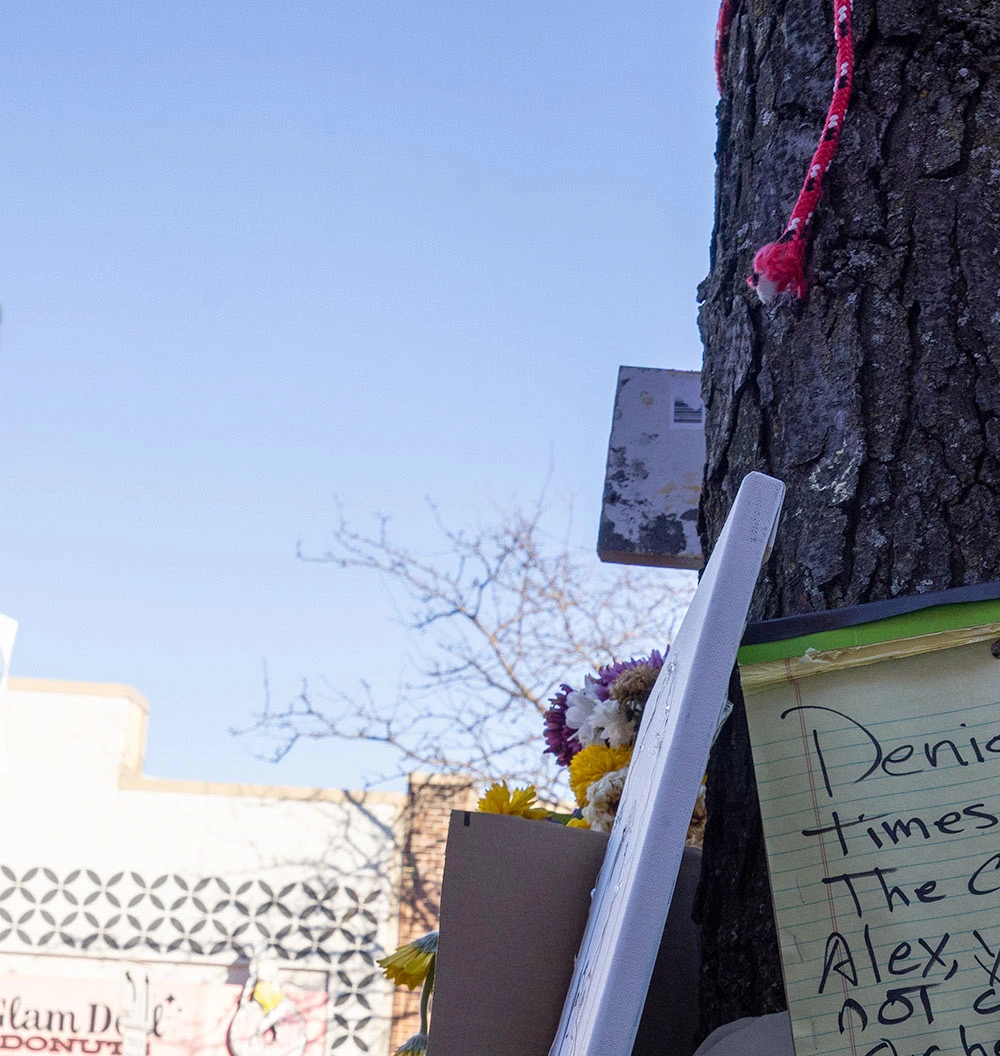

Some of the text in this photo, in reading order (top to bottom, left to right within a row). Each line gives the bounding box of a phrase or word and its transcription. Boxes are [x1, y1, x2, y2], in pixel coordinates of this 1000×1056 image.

[801, 803, 998, 857] times
[822, 866, 949, 917] The
[818, 924, 959, 994] Alex,
[0, 996, 164, 1038] lam Dl
